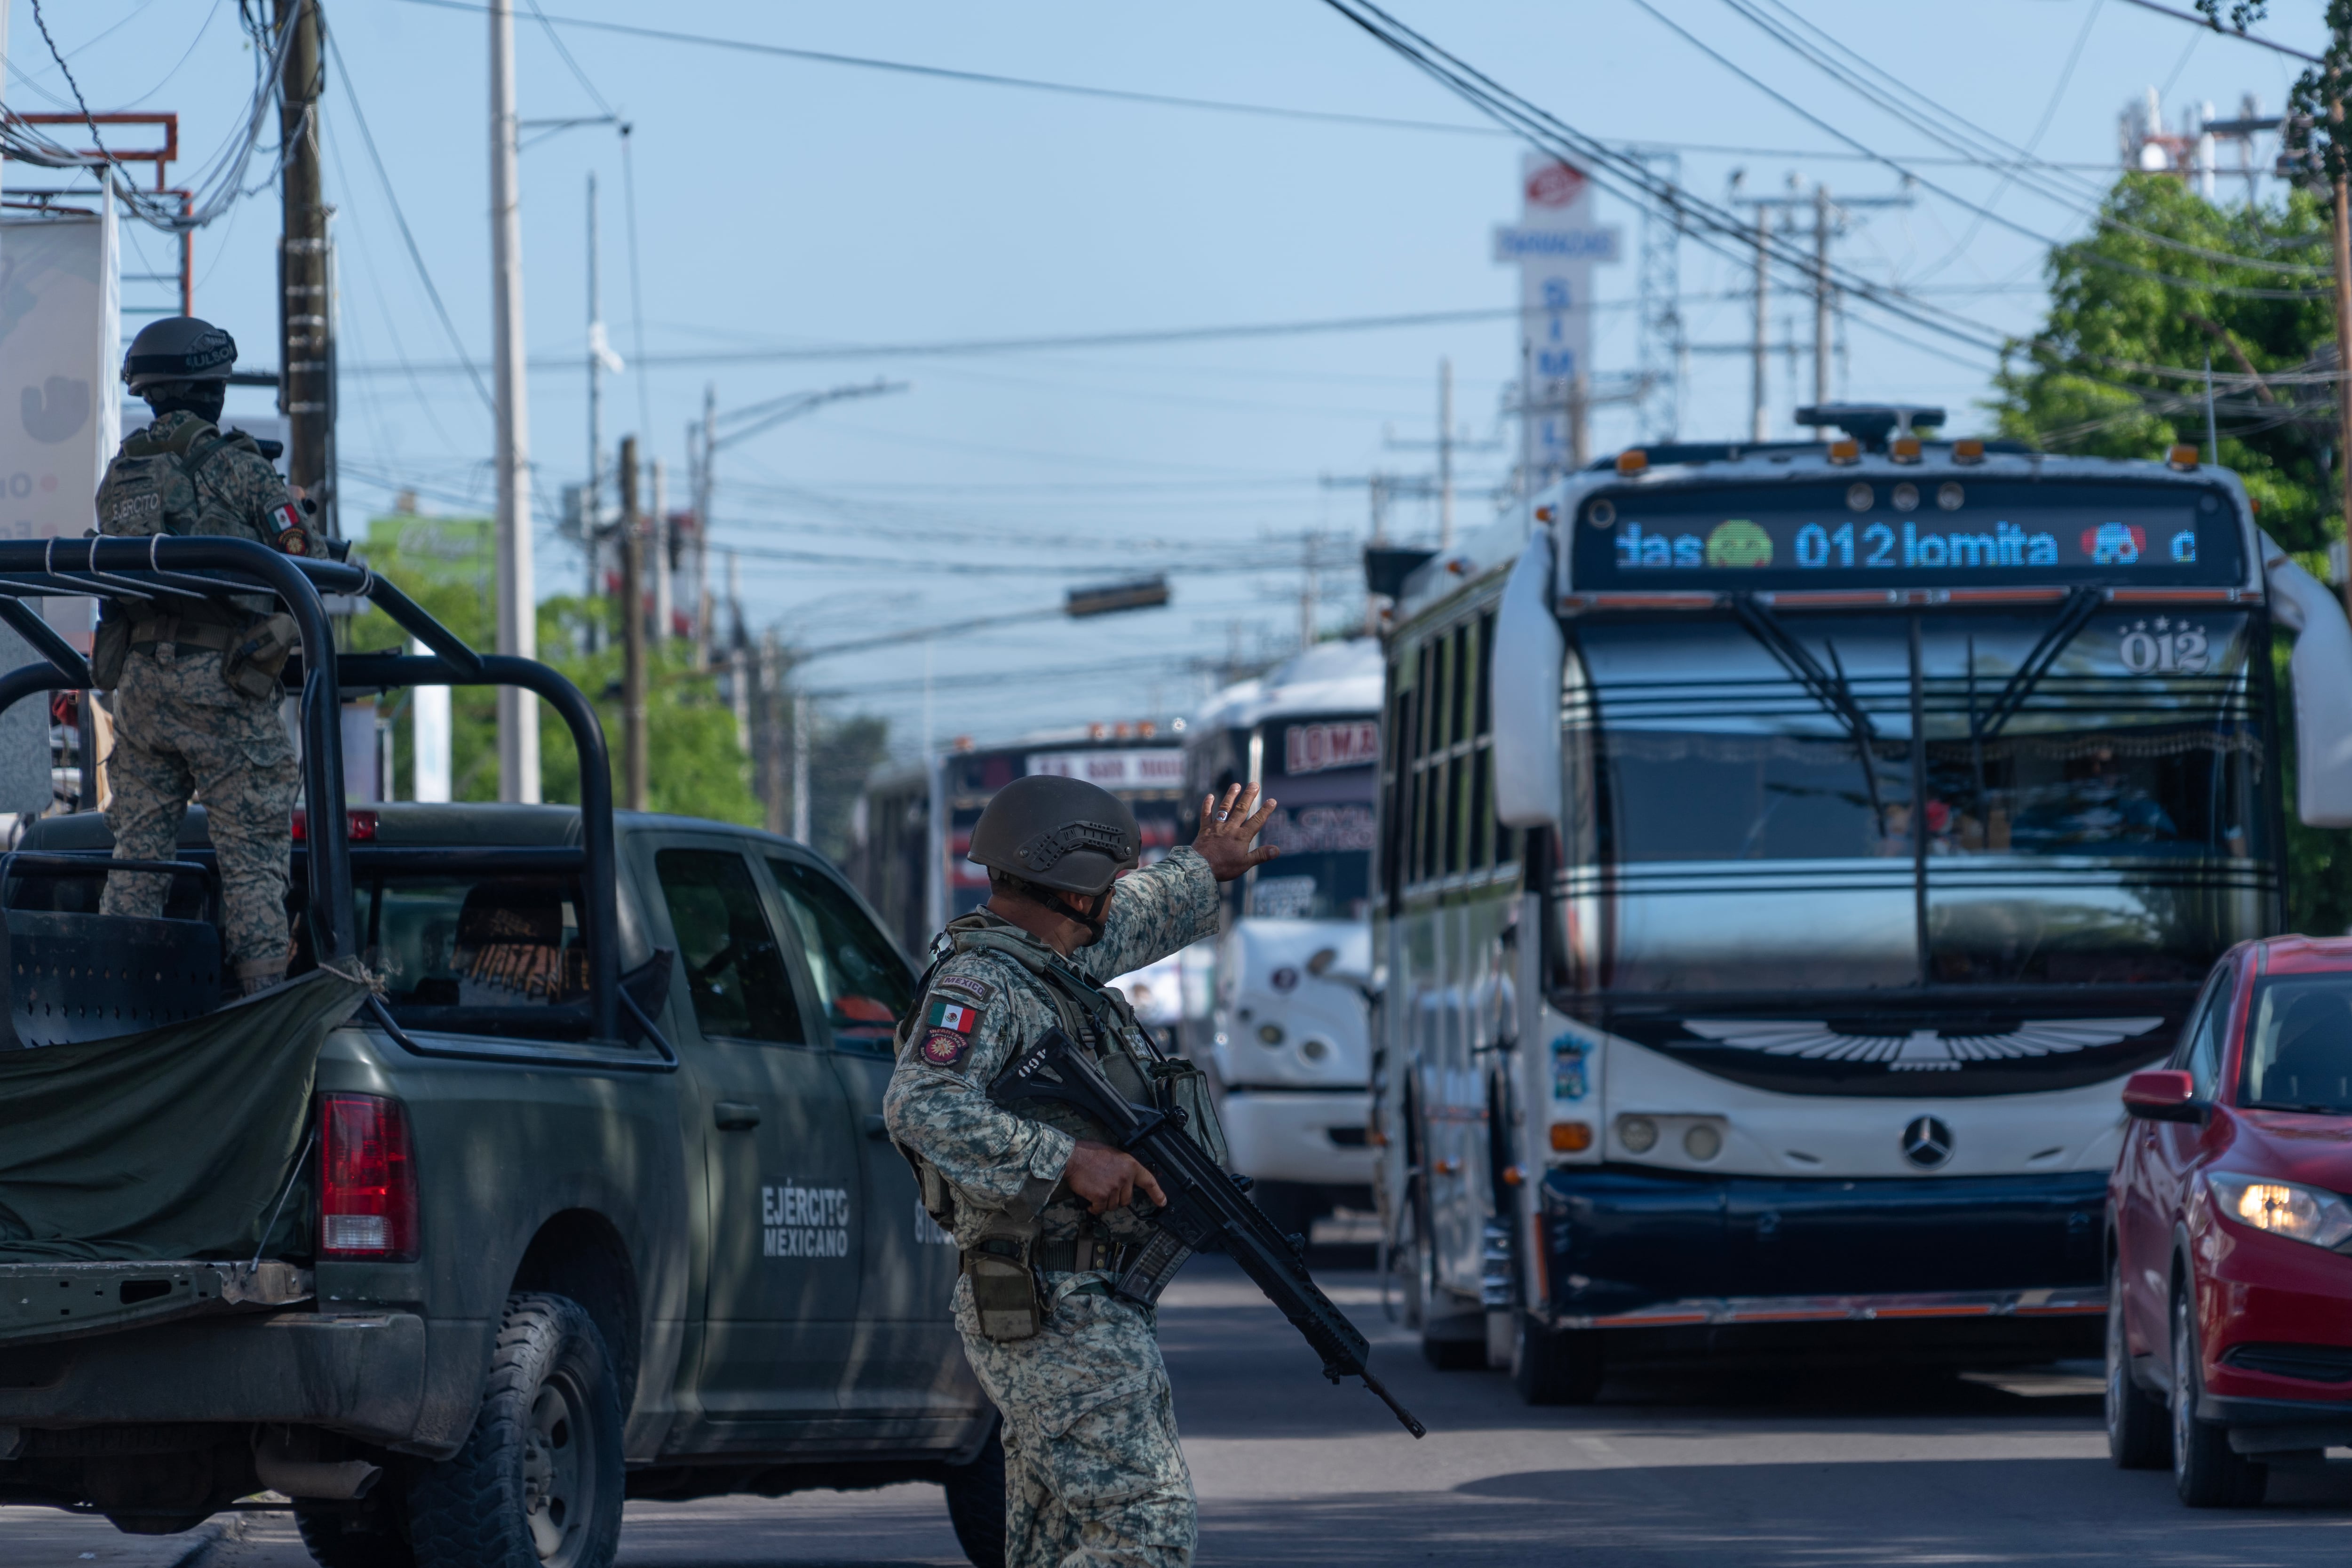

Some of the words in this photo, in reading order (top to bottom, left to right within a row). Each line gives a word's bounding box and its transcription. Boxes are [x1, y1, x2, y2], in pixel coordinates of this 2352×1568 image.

[2120, 631, 2209, 674] 012
[944, 976, 985, 995] MEXICO
[762, 1177, 848, 1226] EJÉRCITO
[764, 1228, 848, 1258] MEXICANO
